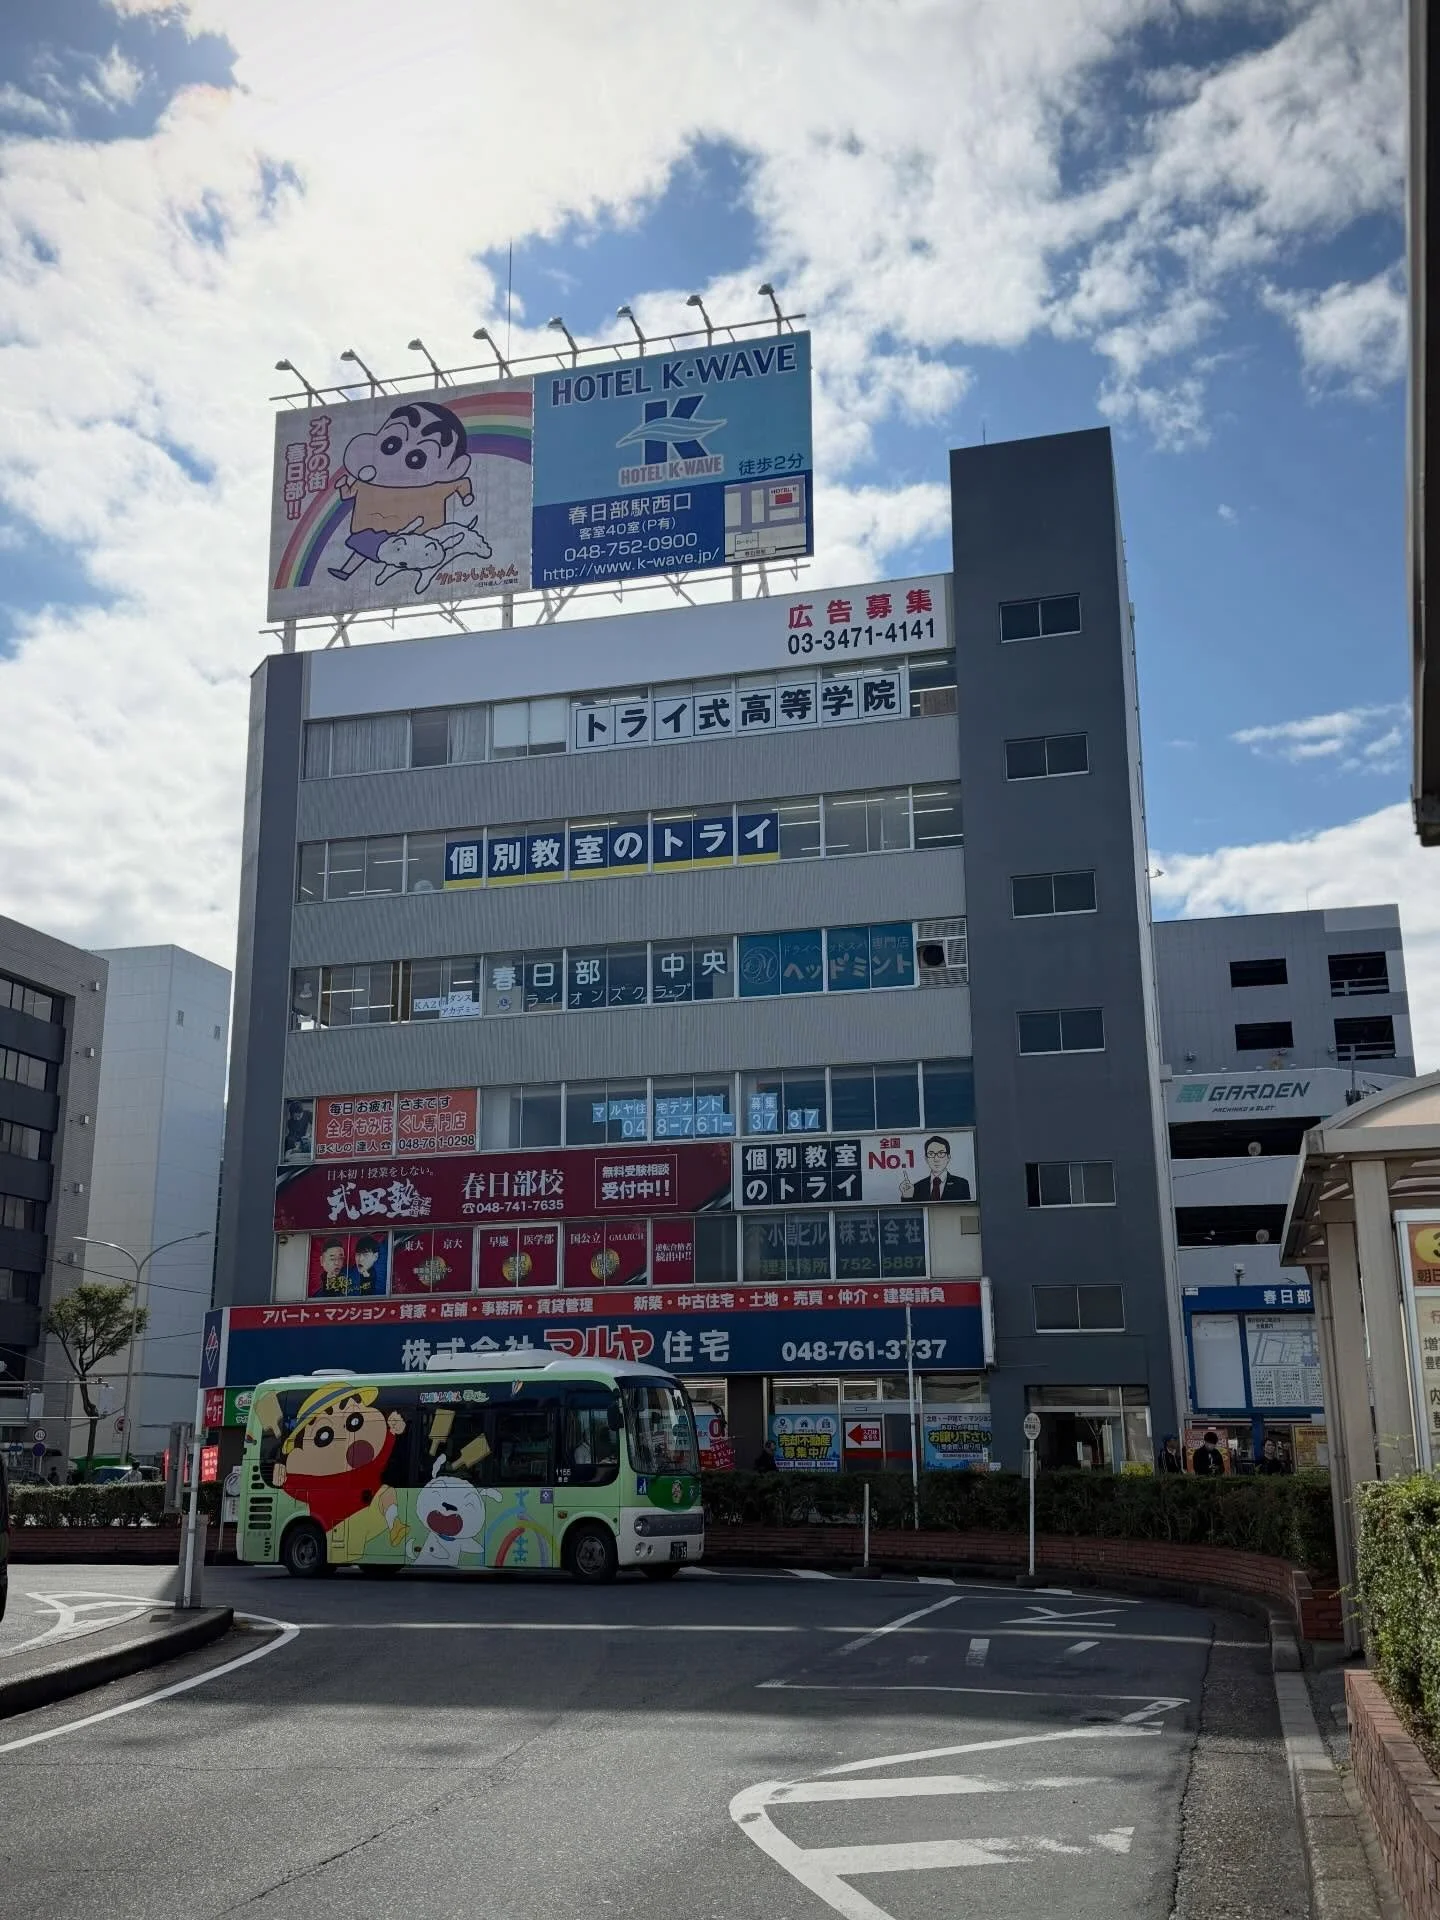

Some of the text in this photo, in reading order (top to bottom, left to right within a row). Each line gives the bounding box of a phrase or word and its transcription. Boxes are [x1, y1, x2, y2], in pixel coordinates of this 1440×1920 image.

[552, 366, 651, 407] HOTEL
[308, 415, 331, 493] オラの街
[738, 453, 805, 475] 徒歩2分
[620, 464, 663, 485] HOTEL
[568, 492, 692, 525] 春日部駅西口
[579, 517, 676, 540] 客室40室(P有)
[564, 533, 698, 562] 048-752-0900
[788, 589, 932, 630] 広告募集
[788, 618, 935, 655] 03-3471-4141
[588, 680, 897, 742] トライ式高等学院
[450, 818, 771, 875] 個別教室のトライ
[492, 950, 727, 990] 春日部 中央
[783, 952, 913, 980] ヘッドミント
[1208, 1082, 1310, 1102] GARDEN
[327, 1112, 467, 1138] 全身もみほぐし専門店
[399, 1135, 475, 1151] 048-761-0298
[746, 1143, 858, 1171] 個別教室
[879, 1137, 900, 1149] 全国
[602, 1163, 669, 1178] 無料受験相談
[868, 1150, 915, 1170] No.1
[461, 1168, 565, 1200] 春日部校
[746, 1173, 857, 1201] のトライ
[476, 1200, 564, 1214] 048-741-7635
[570, 1232, 601, 1245] 国公立
[1263, 1288, 1312, 1305] 春日部
